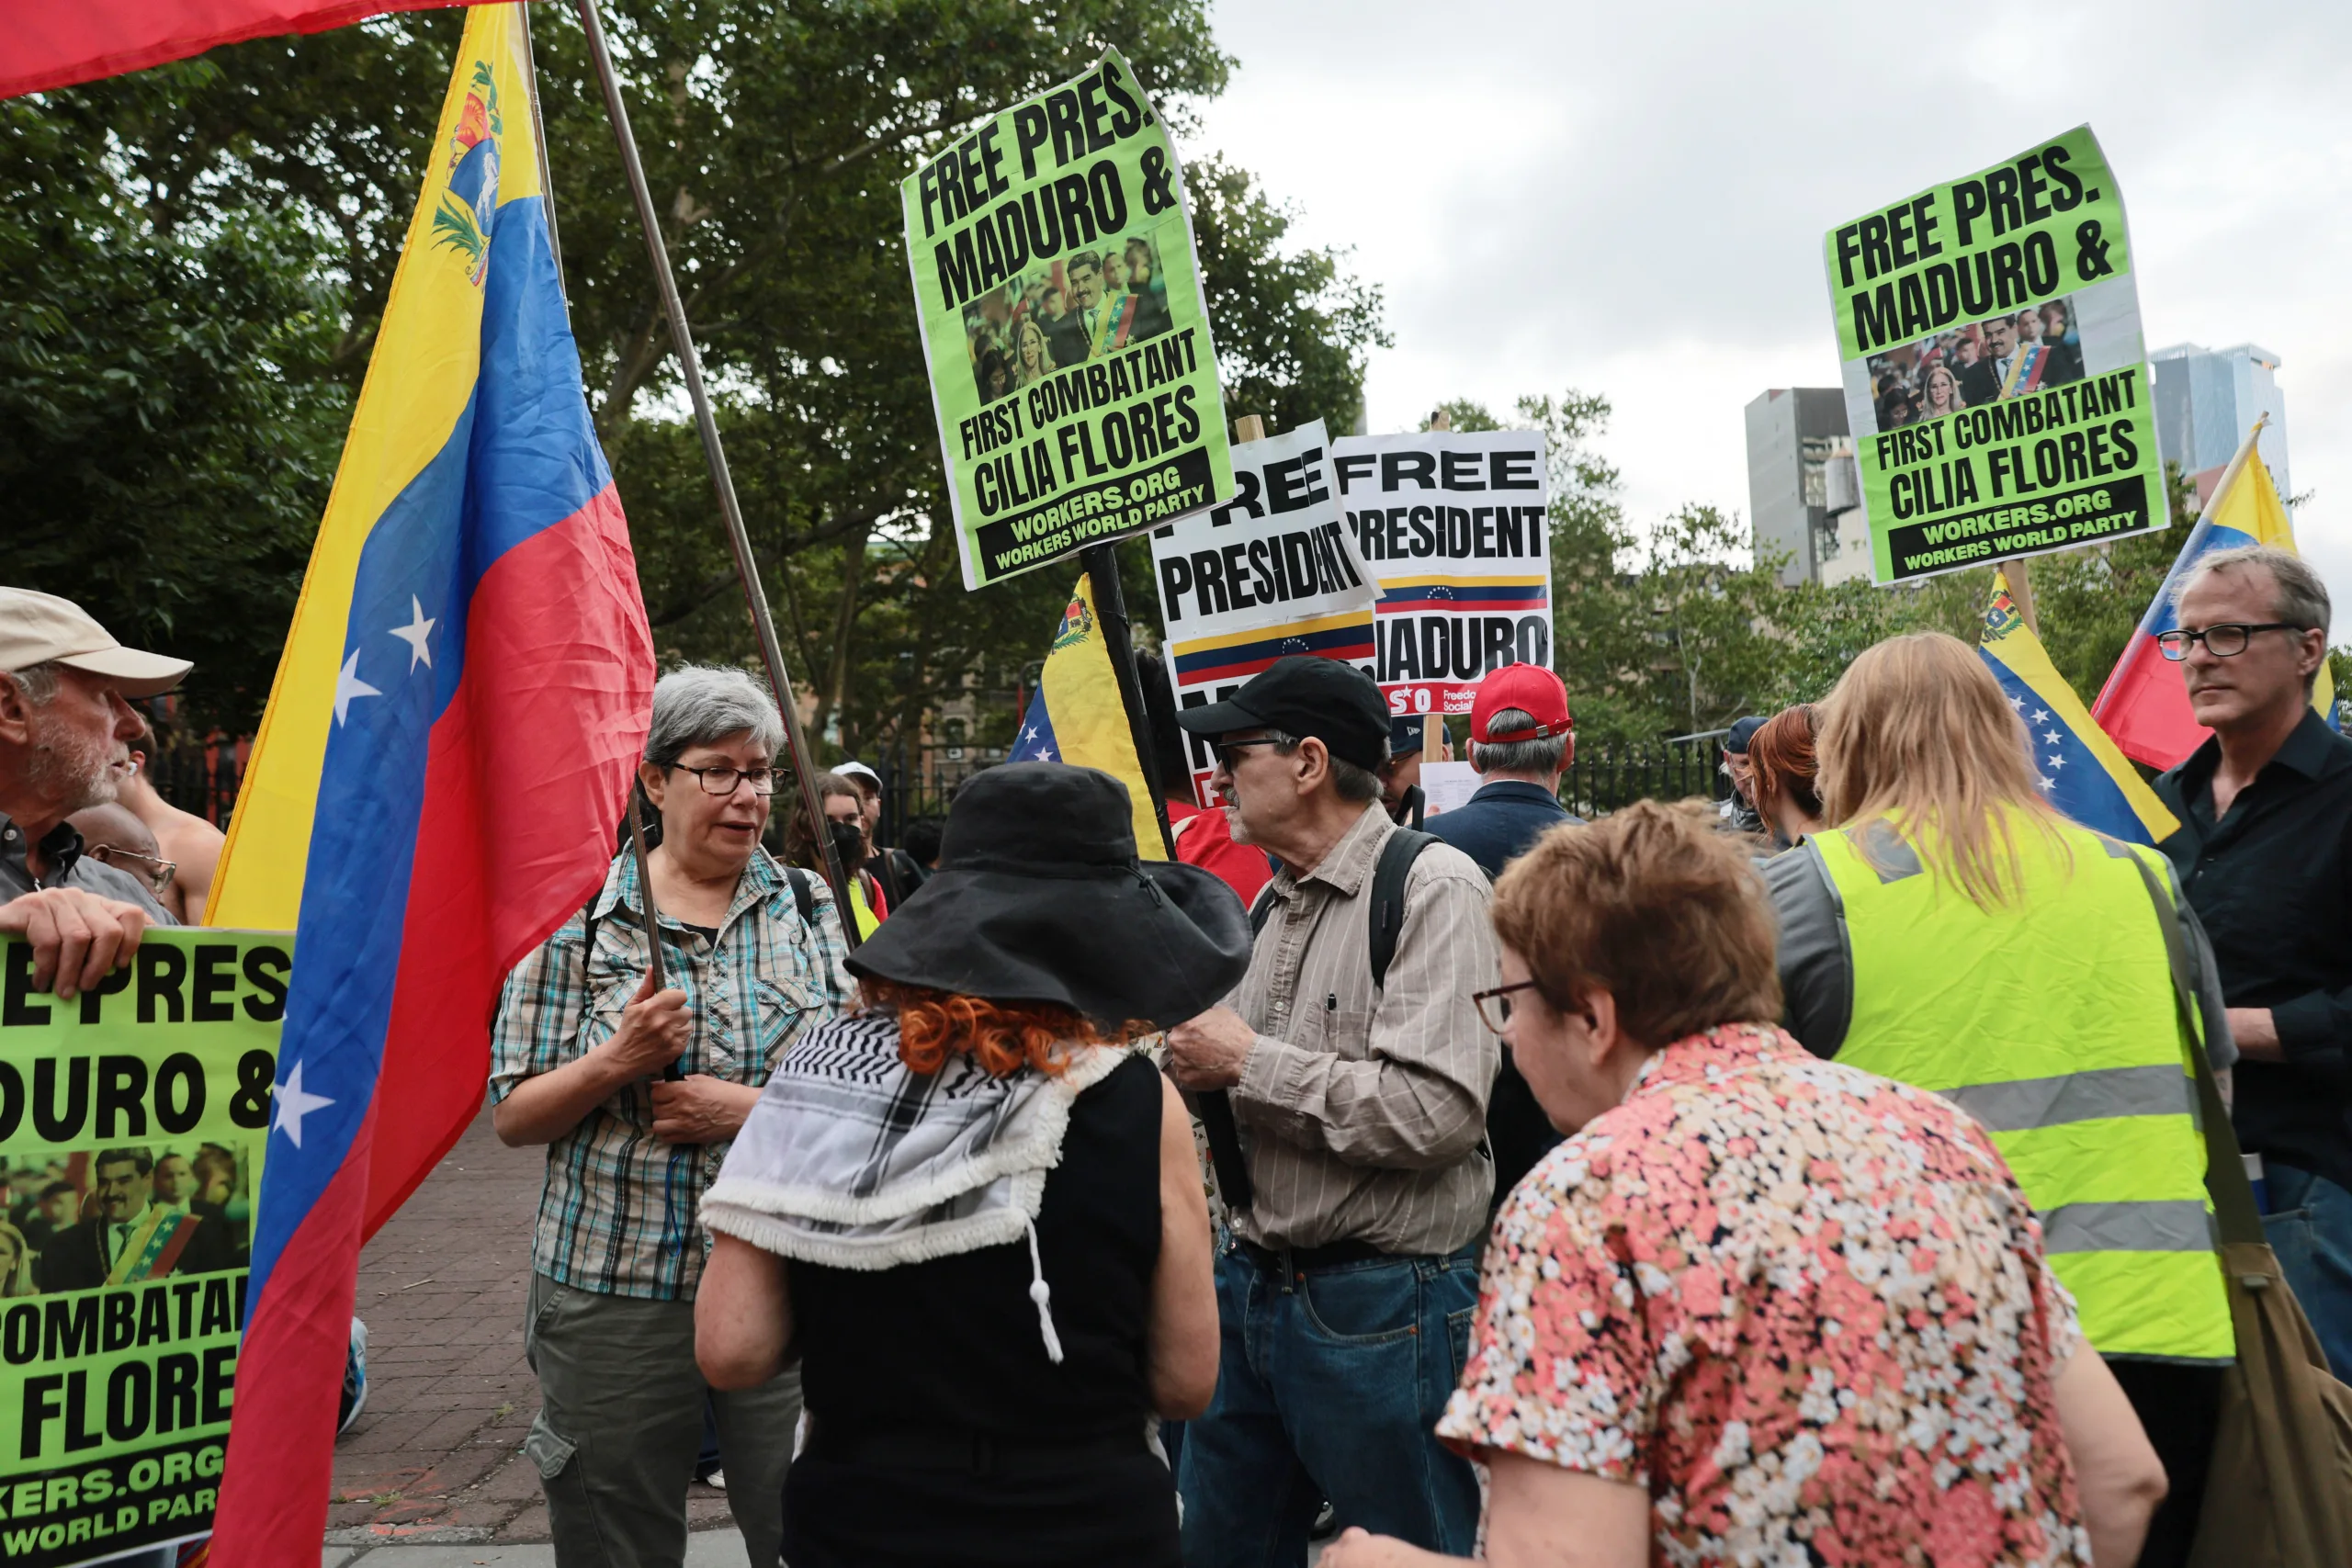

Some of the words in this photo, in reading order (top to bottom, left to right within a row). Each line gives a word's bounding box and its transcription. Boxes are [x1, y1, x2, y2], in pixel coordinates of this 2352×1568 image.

[919, 120, 1010, 239] FREE
[1013, 62, 1154, 181] PRES.
[934, 159, 1127, 311] MADURO
[1140, 146, 1177, 215] &
[1836, 192, 1942, 288] FREE
[1951, 145, 2100, 247] PRES.
[1851, 231, 2060, 352] MADURO
[2075, 220, 2115, 281] &
[959, 396, 1023, 461] FIRST
[1028, 327, 1197, 430] COMBATANT
[1875, 420, 1947, 470] FIRST
[1954, 369, 2136, 450] COMBATANT
[974, 437, 1057, 516] CILIA
[1057, 385, 1201, 484] FLORES
[1154, 446, 1329, 539] REE
[1333, 451, 1539, 495] FREE
[1890, 457, 1980, 521] CILIA
[1987, 419, 2139, 499] FLORES
[996, 524, 1071, 570] WORKERS
[1071, 505, 1142, 544] WORLD
[1146, 484, 1204, 522] PARTY
[1011, 467, 1182, 543] WORKERS.ORG
[1904, 540, 1991, 571] WORKERS
[1993, 525, 2067, 552] WORLD
[2071, 510, 2138, 539] PARTY
[1922, 490, 2111, 546] WORKERS.ORG
[1159, 521, 1363, 622] PRESIDENT
[1443, 689, 1476, 700] Freedo
[1443, 700, 1475, 711] Sociali
[0, 1274, 248, 1366] OMBATA
[19, 1345, 237, 1461] FLORE
[2, 1506, 140, 1558] WORLD
[147, 1486, 221, 1527] PAR
